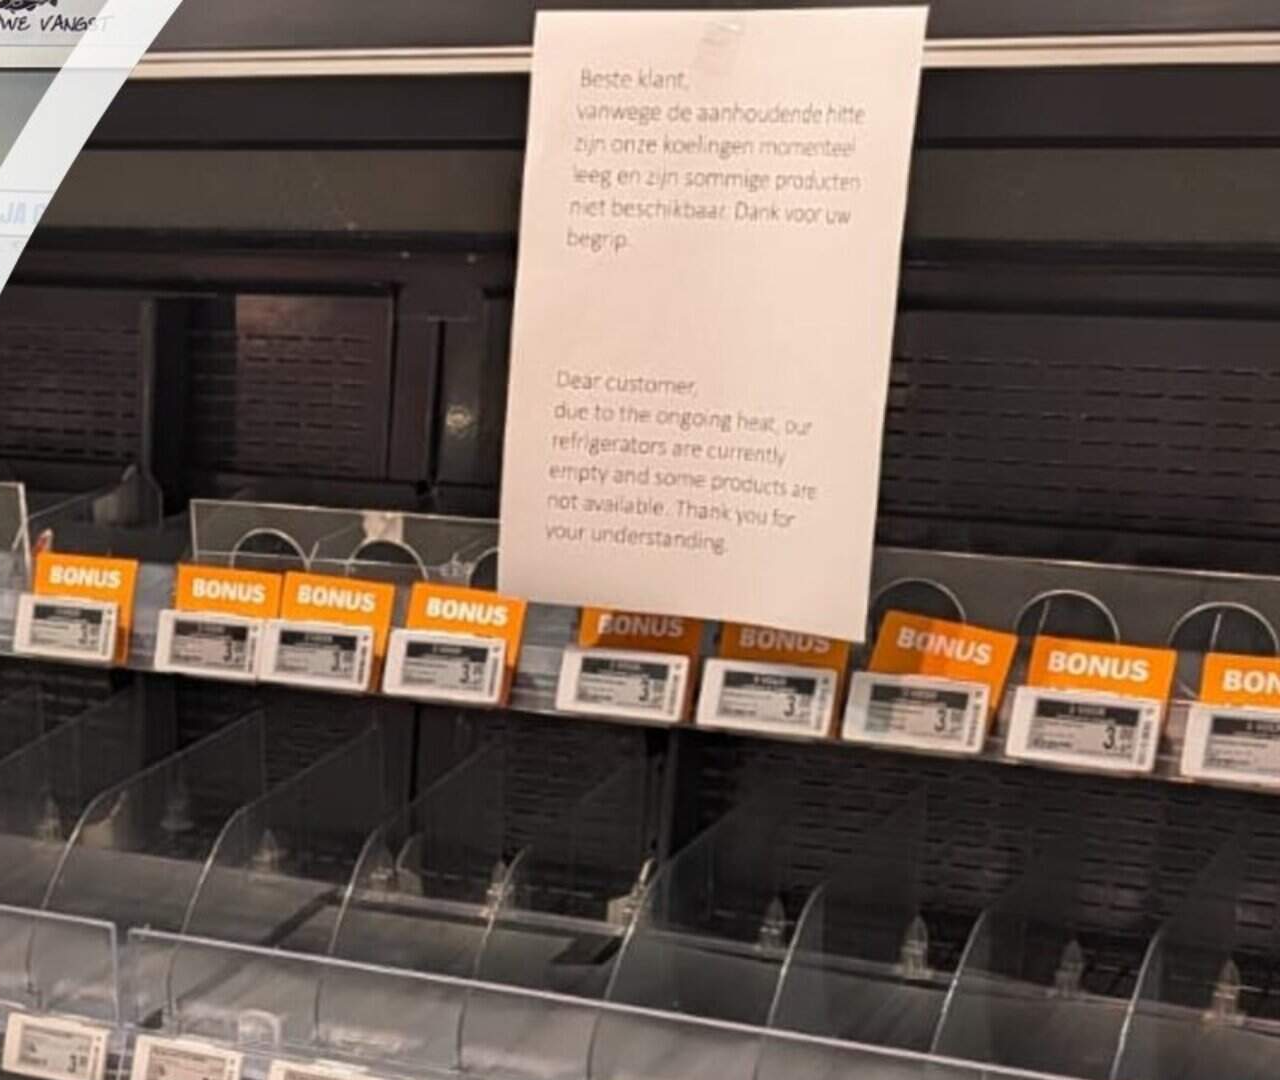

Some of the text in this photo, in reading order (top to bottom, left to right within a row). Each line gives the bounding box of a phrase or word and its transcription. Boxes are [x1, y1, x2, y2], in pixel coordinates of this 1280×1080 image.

[580, 69, 633, 89] Beste
[577, 103, 866, 126] vanwege de aanhoudende hitte
[574, 134, 857, 159] zijn onze koelingen momenteel
[573, 164, 862, 194] leeg en zijn sommige producten
[569, 198, 606, 217] niet
[734, 201, 780, 222] Dank
[785, 206, 823, 223] voor
[825, 207, 852, 225] uw
[557, 370, 697, 398] Dear customer,
[554, 401, 590, 420] due
[595, 404, 615, 422] to
[619, 405, 652, 424] the
[656, 410, 732, 432] ongoing
[784, 419, 814, 436] our
[552, 431, 787, 467] refrigerators are currently
[548, 464, 818, 500] empty and some products are
[547, 493, 579, 511] not
[675, 499, 731, 520] Thank
[734, 508, 767, 527] you
[772, 508, 796, 528] for
[545, 523, 585, 542] your
[49, 564, 121, 590] BONUS
[192, 577, 266, 604] BONUS
[297, 584, 375, 613] BONUS
[425, 597, 509, 627] BONUS
[597, 613, 685, 638] BONUS
[739, 628, 832, 654] BONUS
[896, 626, 993, 666] BONUS
[1047, 650, 1151, 682] BONUS
[1223, 669, 1280, 695] BON
